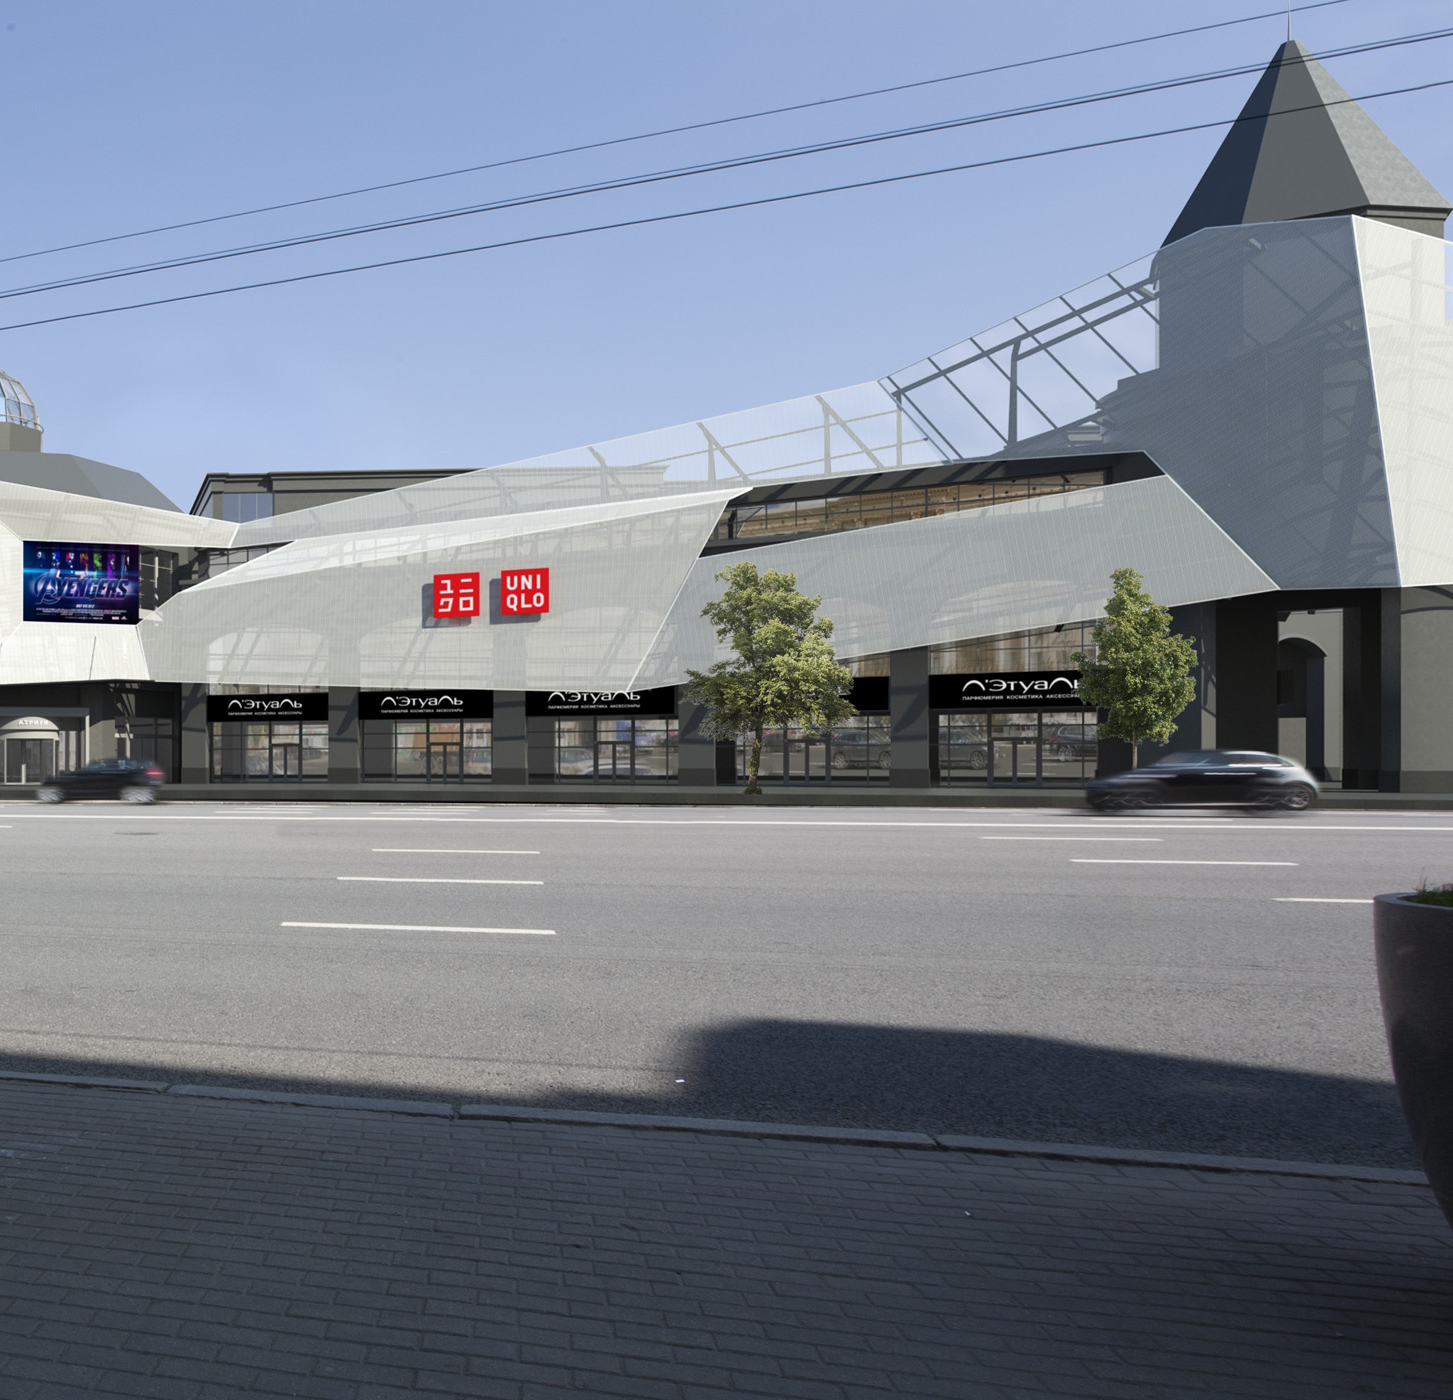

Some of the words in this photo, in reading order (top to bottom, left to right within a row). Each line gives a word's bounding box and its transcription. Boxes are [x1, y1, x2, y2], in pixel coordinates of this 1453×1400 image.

[34, 574, 130, 605] AVENGERS
[439, 578, 474, 594] ユニ
[506, 574, 541, 590] UNI
[438, 596, 474, 613] クロ
[506, 593, 545, 611] QLO
